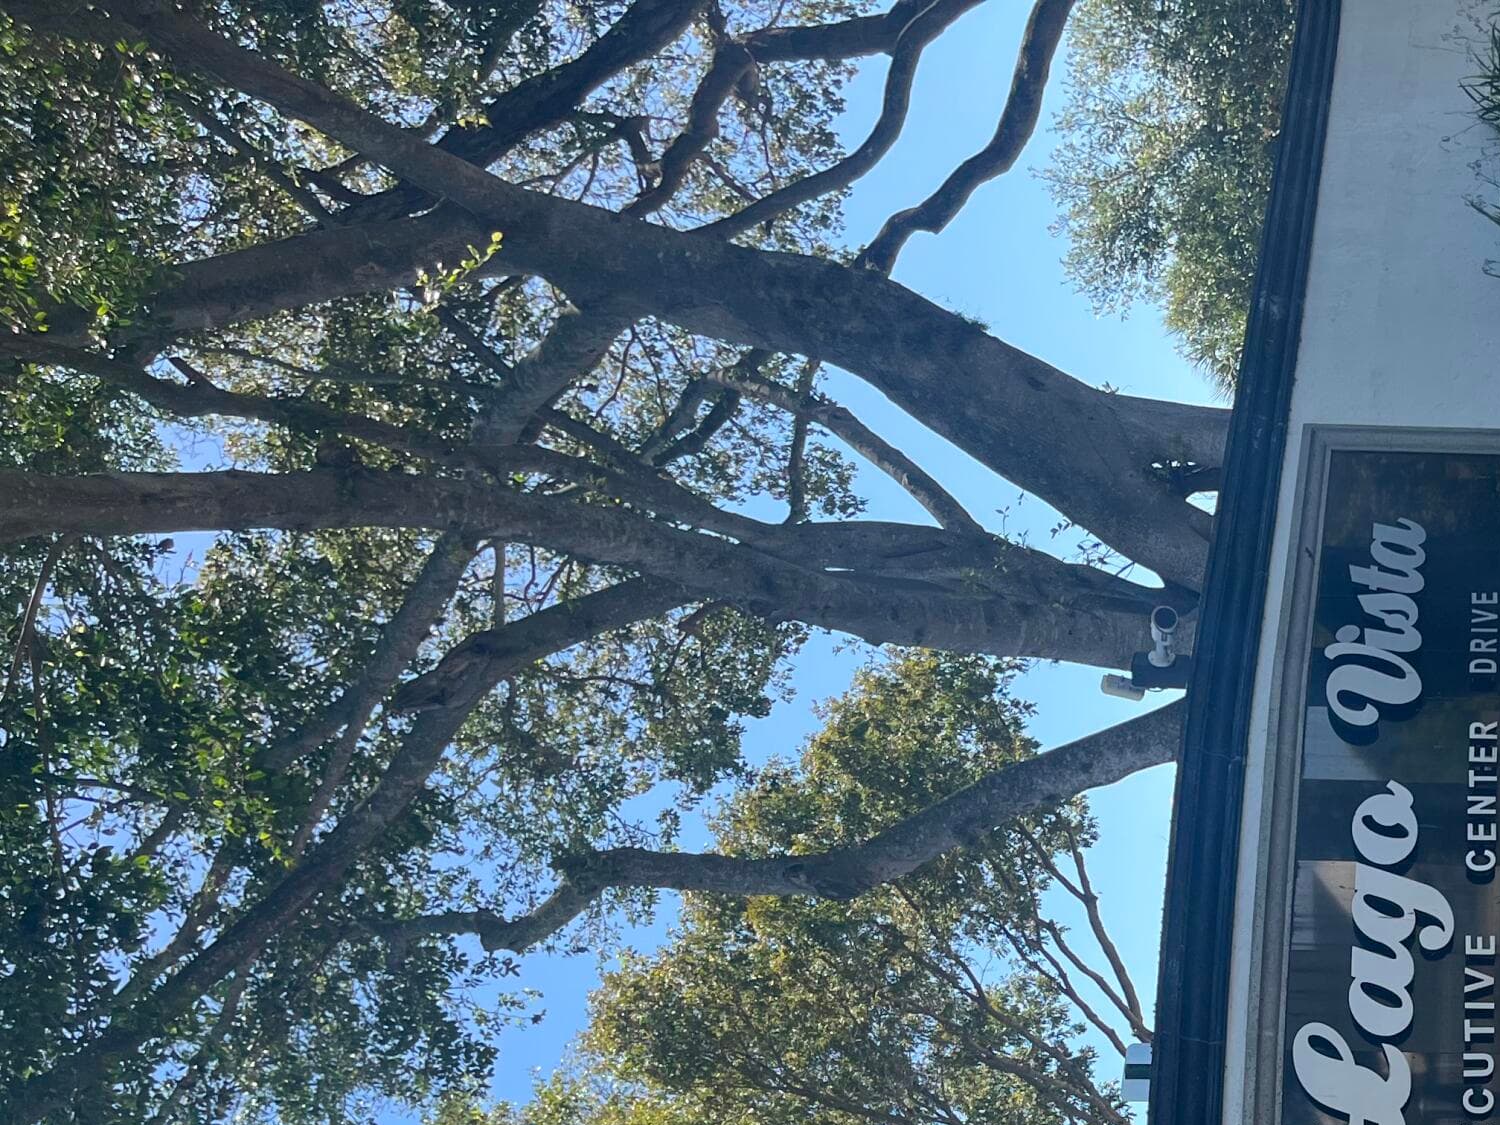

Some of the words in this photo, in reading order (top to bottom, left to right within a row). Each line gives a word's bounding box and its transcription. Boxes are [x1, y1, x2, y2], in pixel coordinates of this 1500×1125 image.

[1326, 516, 1427, 727] Vista
[1469, 591, 1498, 674] DRIVE
[1465, 720, 1498, 872] CENTER
